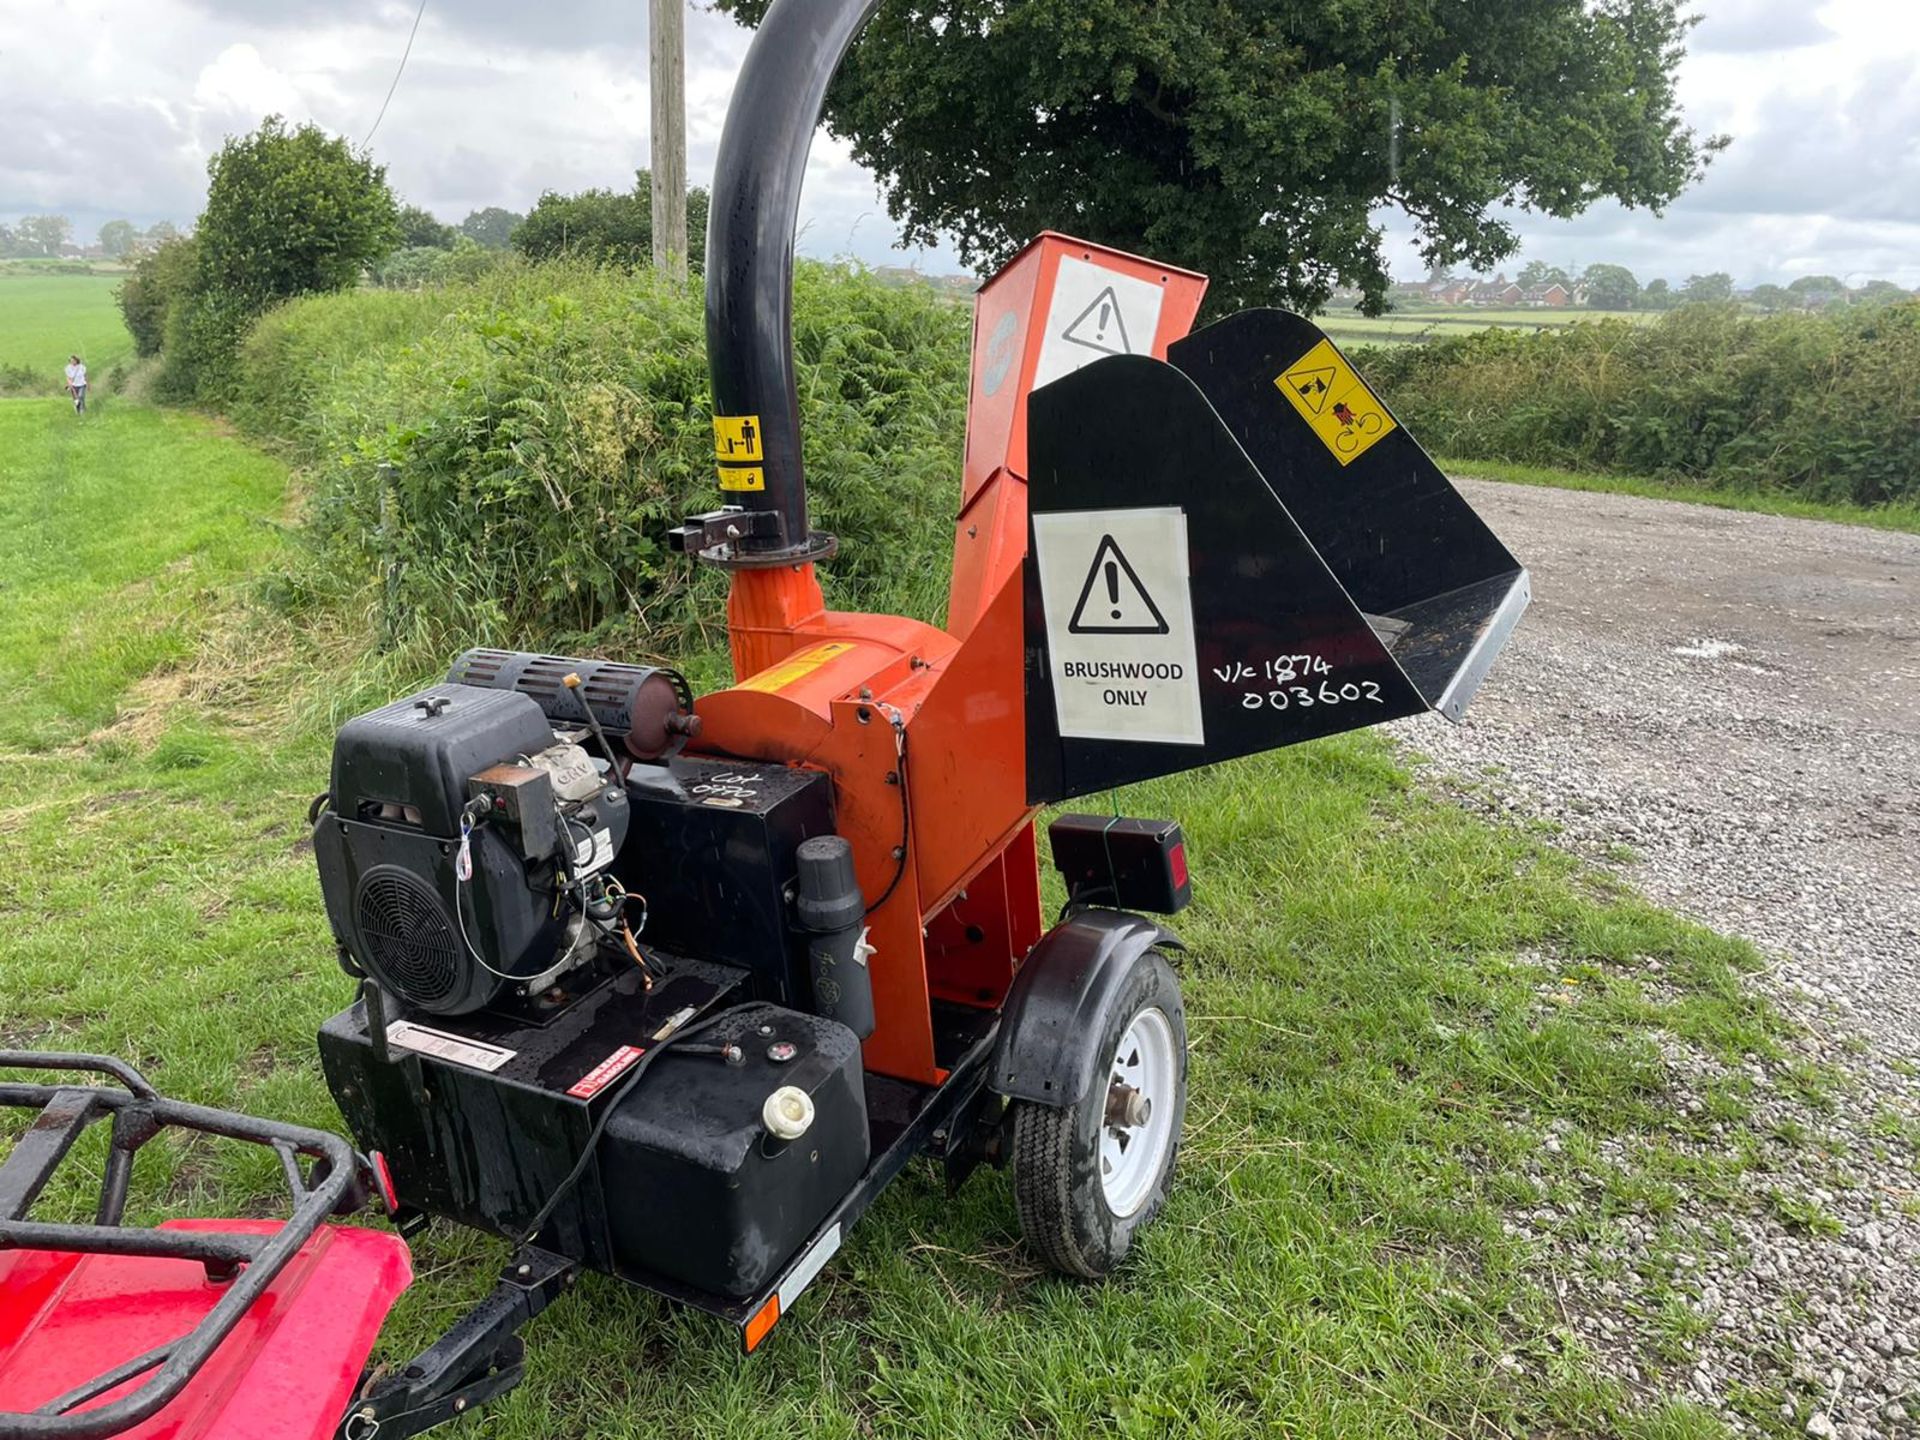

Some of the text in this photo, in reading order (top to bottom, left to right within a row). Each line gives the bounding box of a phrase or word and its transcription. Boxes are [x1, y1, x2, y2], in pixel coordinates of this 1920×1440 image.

[1064, 662, 1183, 680] BRUSHWOOD
[1265, 655, 1333, 685] 1874
[1103, 689, 1148, 706] ONLY
[1242, 681, 1384, 710] 003602
